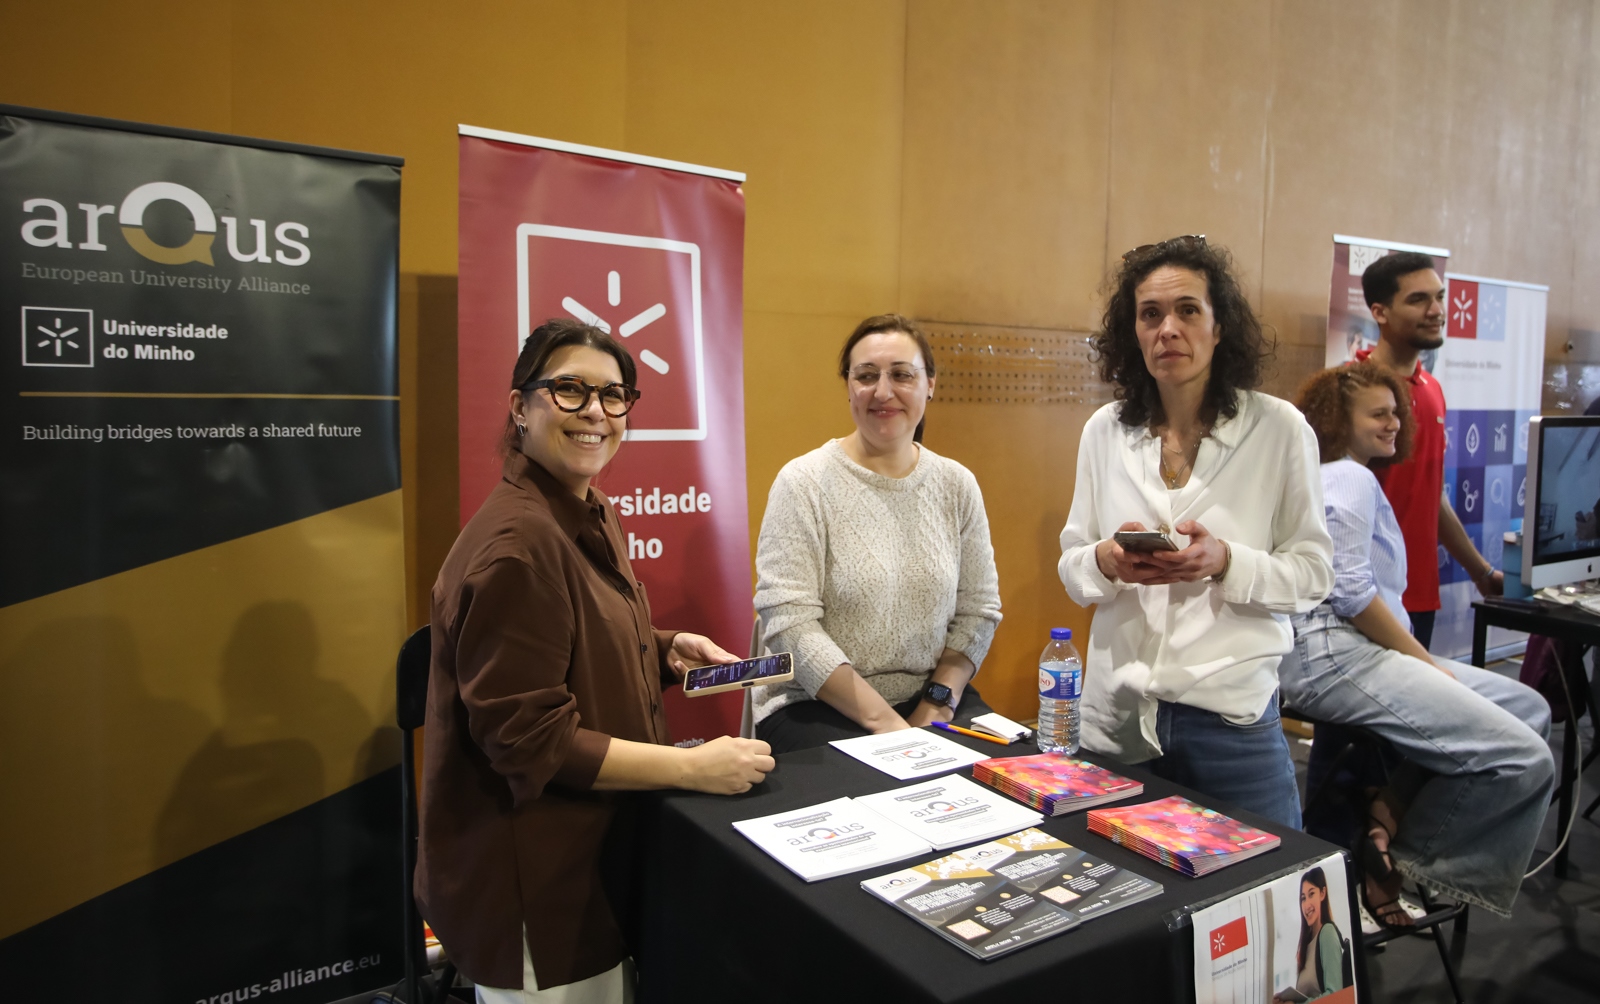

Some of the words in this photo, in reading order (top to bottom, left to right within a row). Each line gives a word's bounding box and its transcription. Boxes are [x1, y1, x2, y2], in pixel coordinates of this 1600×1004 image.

[21, 262, 125, 285] European
[131, 268, 232, 294] University
[237, 275, 311, 296] Alliance
[103, 319, 229, 340] Universidade
[103, 344, 128, 360] do
[134, 345, 196, 362] Minho
[23, 424, 104, 442] Building
[108, 424, 173, 442] bridges
[177, 423, 245, 439] towards
[249, 428, 259, 438] a
[262, 423, 315, 438] shared
[318, 423, 362, 438] future
[608, 486, 711, 516] rsidade
